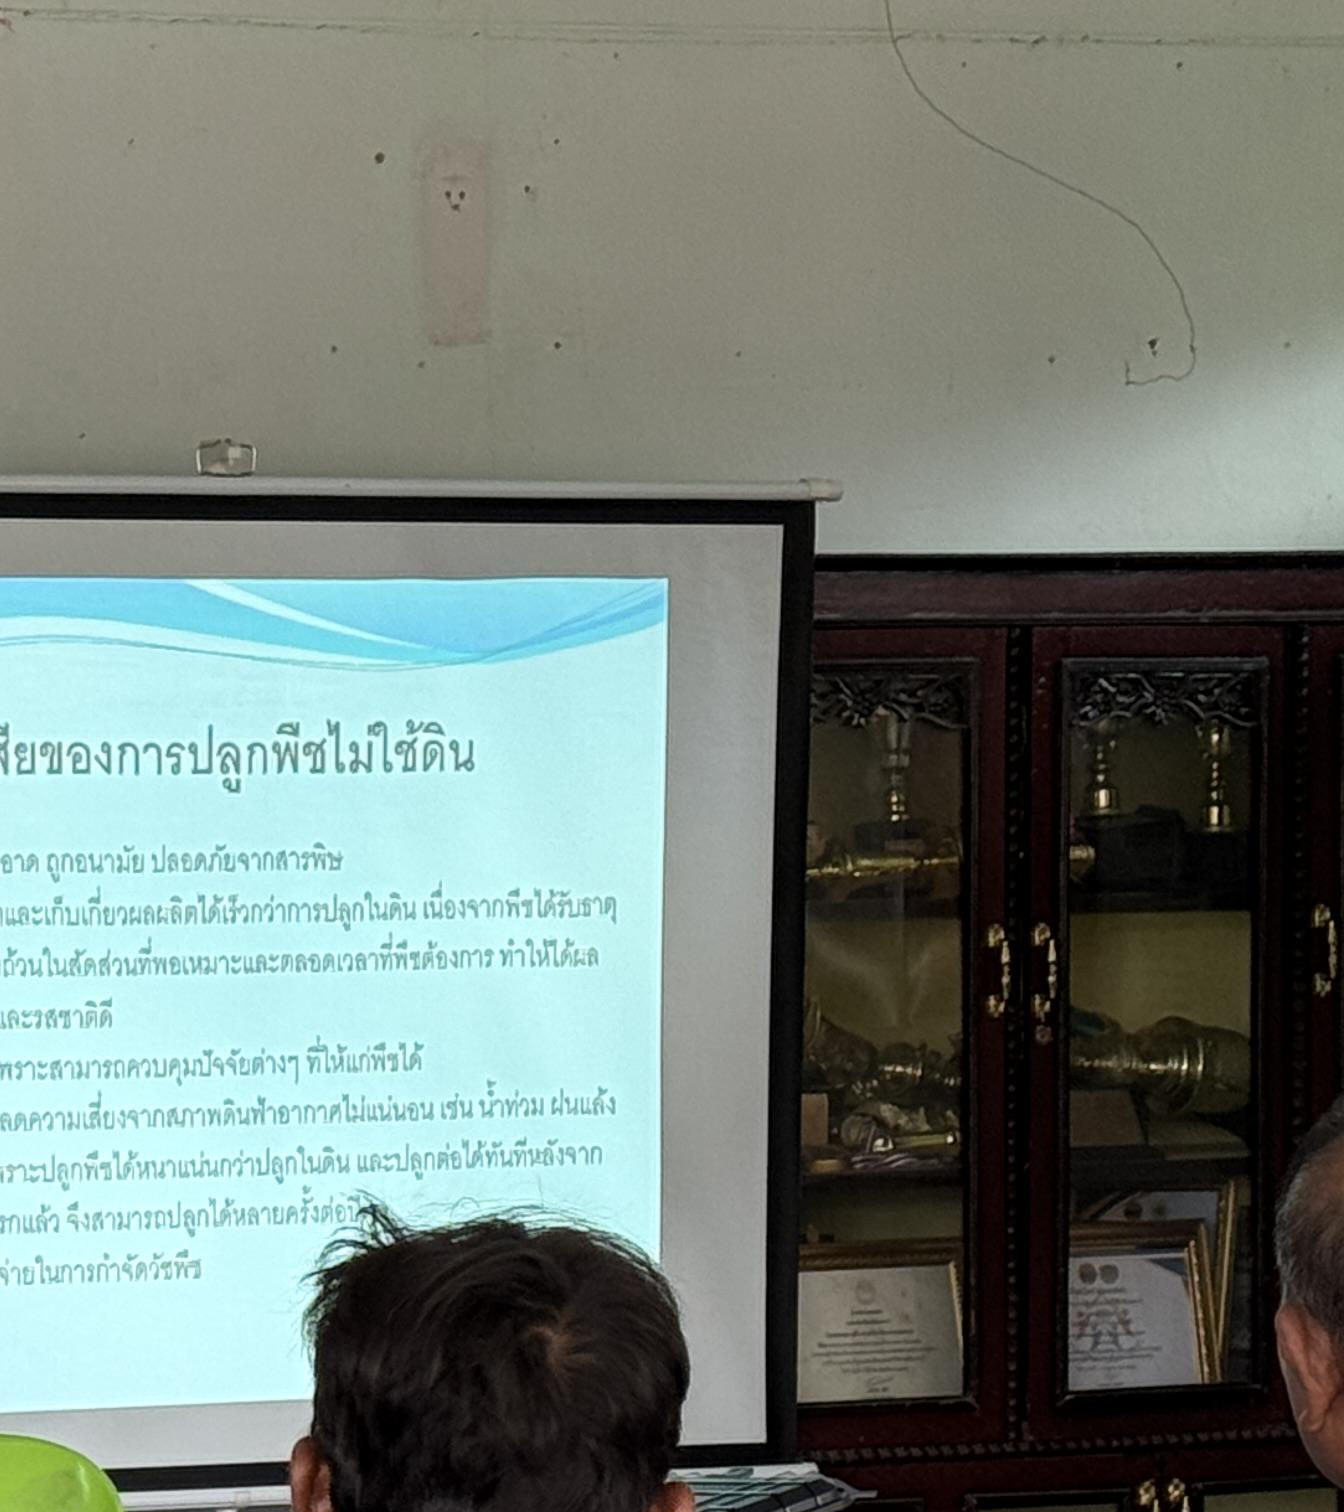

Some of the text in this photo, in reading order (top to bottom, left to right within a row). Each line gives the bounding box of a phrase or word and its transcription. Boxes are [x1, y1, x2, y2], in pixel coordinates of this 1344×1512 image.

[46, 844, 145, 884] ถูกอนามัย
[151, 841, 344, 874] ปลอดภัยจากสารพิษ
[422, 879, 617, 925] เนื่องจากพืชได้รับธาตุ
[498, 937, 599, 968] ทำให้ได้ผล
[306, 1034, 425, 1075] ที่ให้แก่พืชได้
[440, 1092, 474, 1121] เช่น
[478, 1079, 545, 1119] น้ำท่วม
[550, 1085, 617, 1117] ฝนแล้ง
